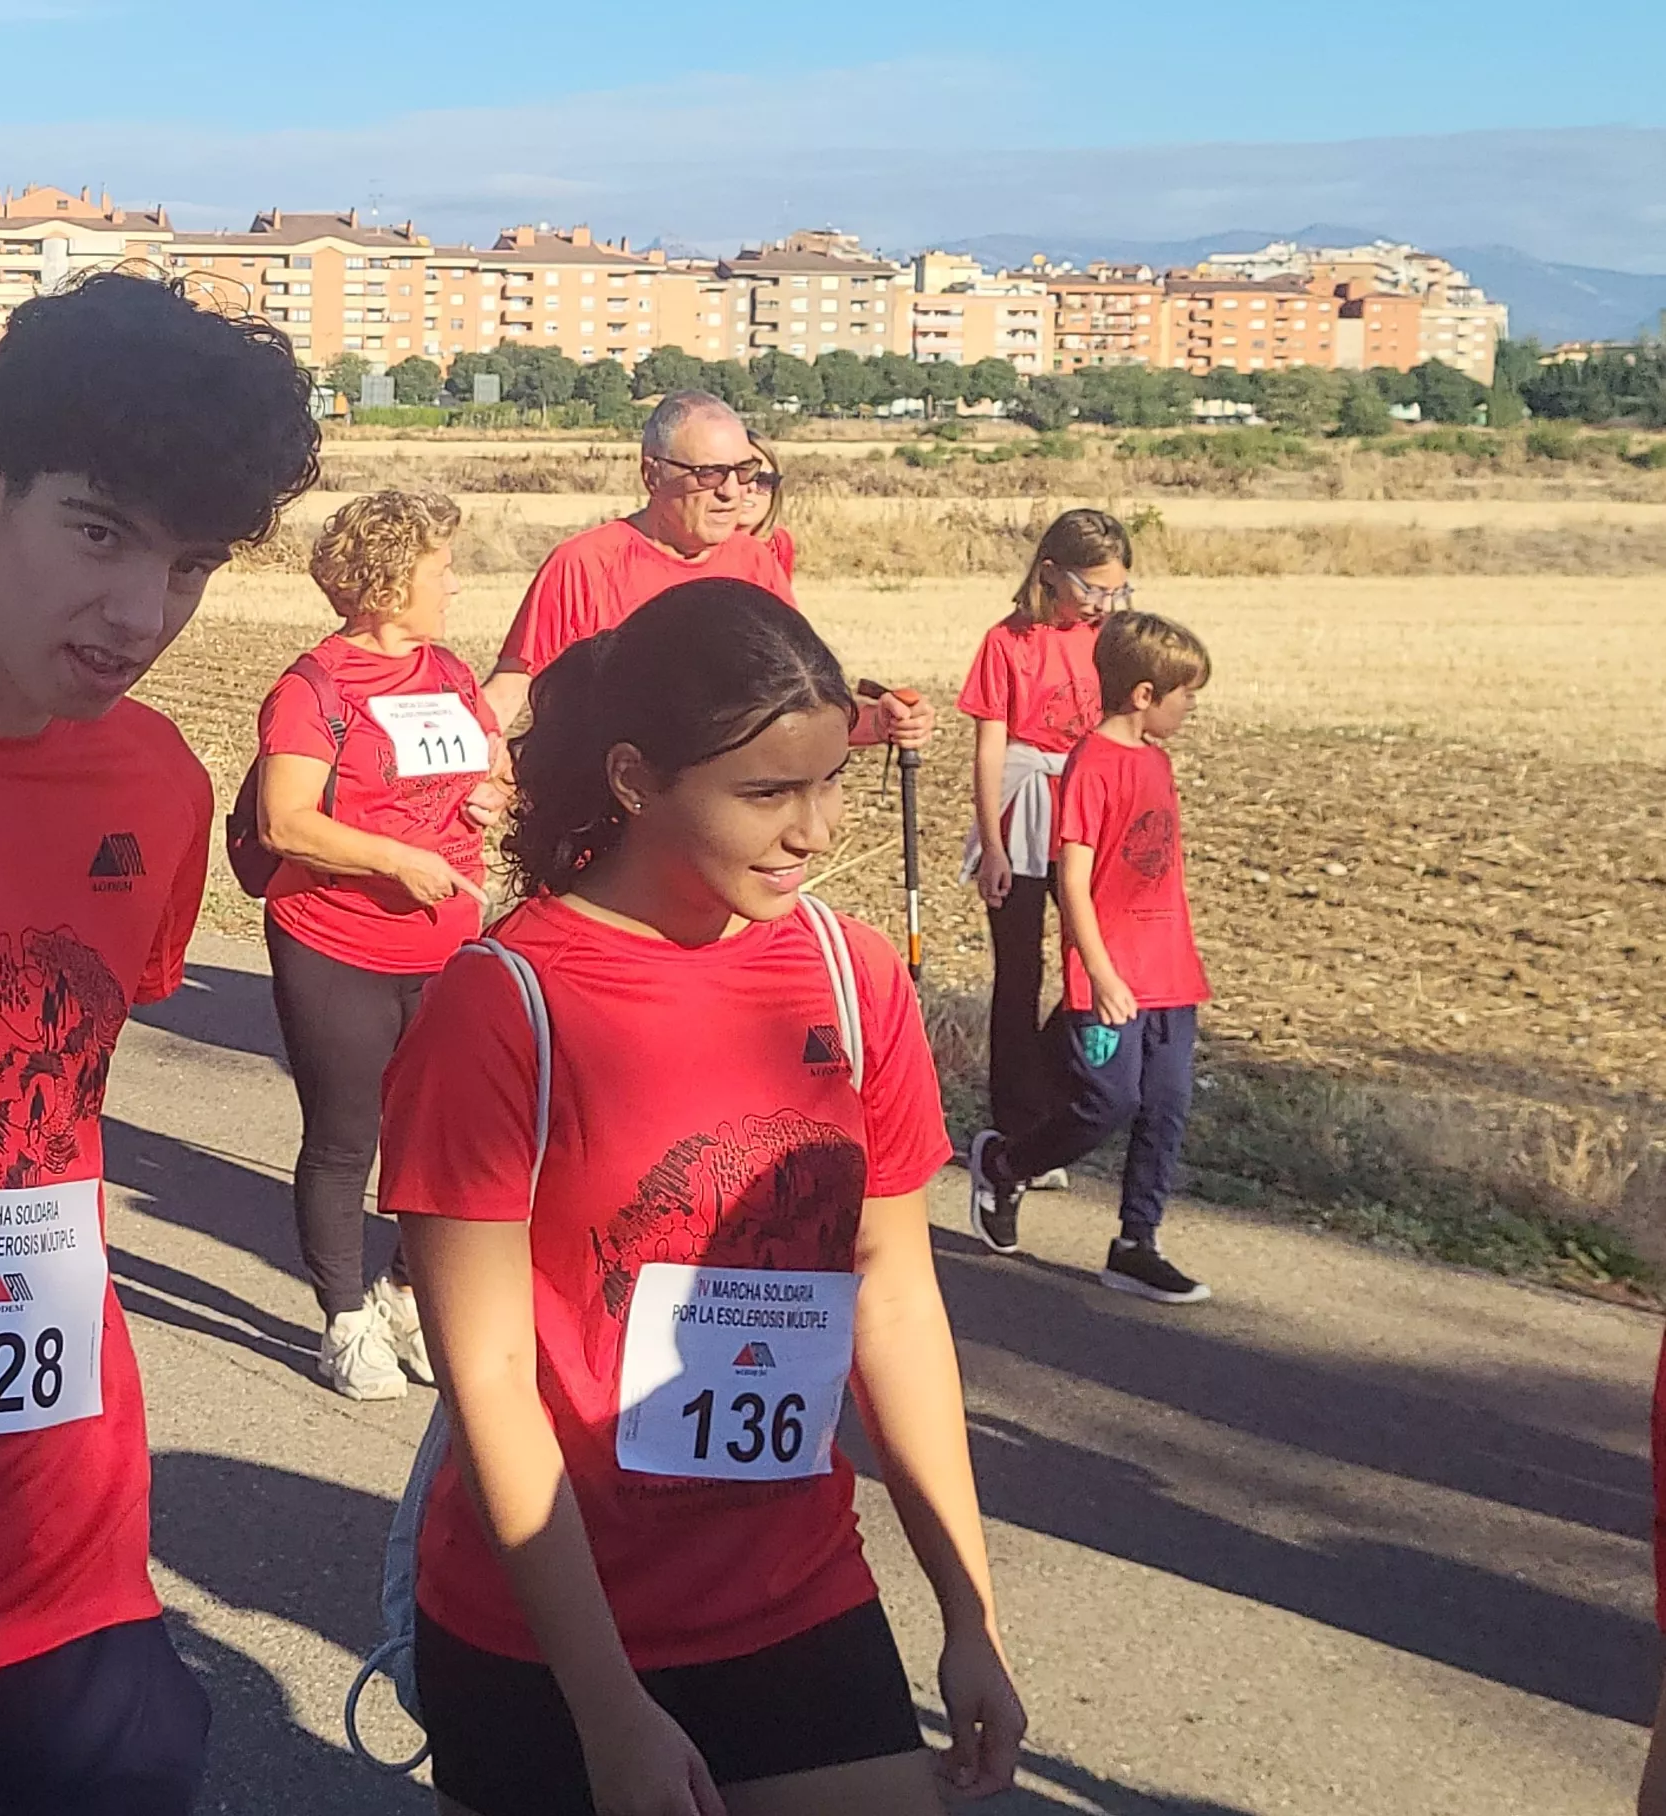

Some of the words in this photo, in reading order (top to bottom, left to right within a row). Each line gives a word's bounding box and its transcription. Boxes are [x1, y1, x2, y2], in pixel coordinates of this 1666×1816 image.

[418, 735, 466, 765] 111
[15, 1200, 59, 1225] SOLIDARIA
[698, 1278, 710, 1298] IV
[712, 1280, 761, 1301] MARCHA
[764, 1282, 815, 1302] SOLIDARIA
[672, 1304, 697, 1325] POR
[699, 1304, 715, 1325] LA
[716, 1306, 785, 1329] ESCLEROSIS
[682, 1388, 806, 1463] 136
